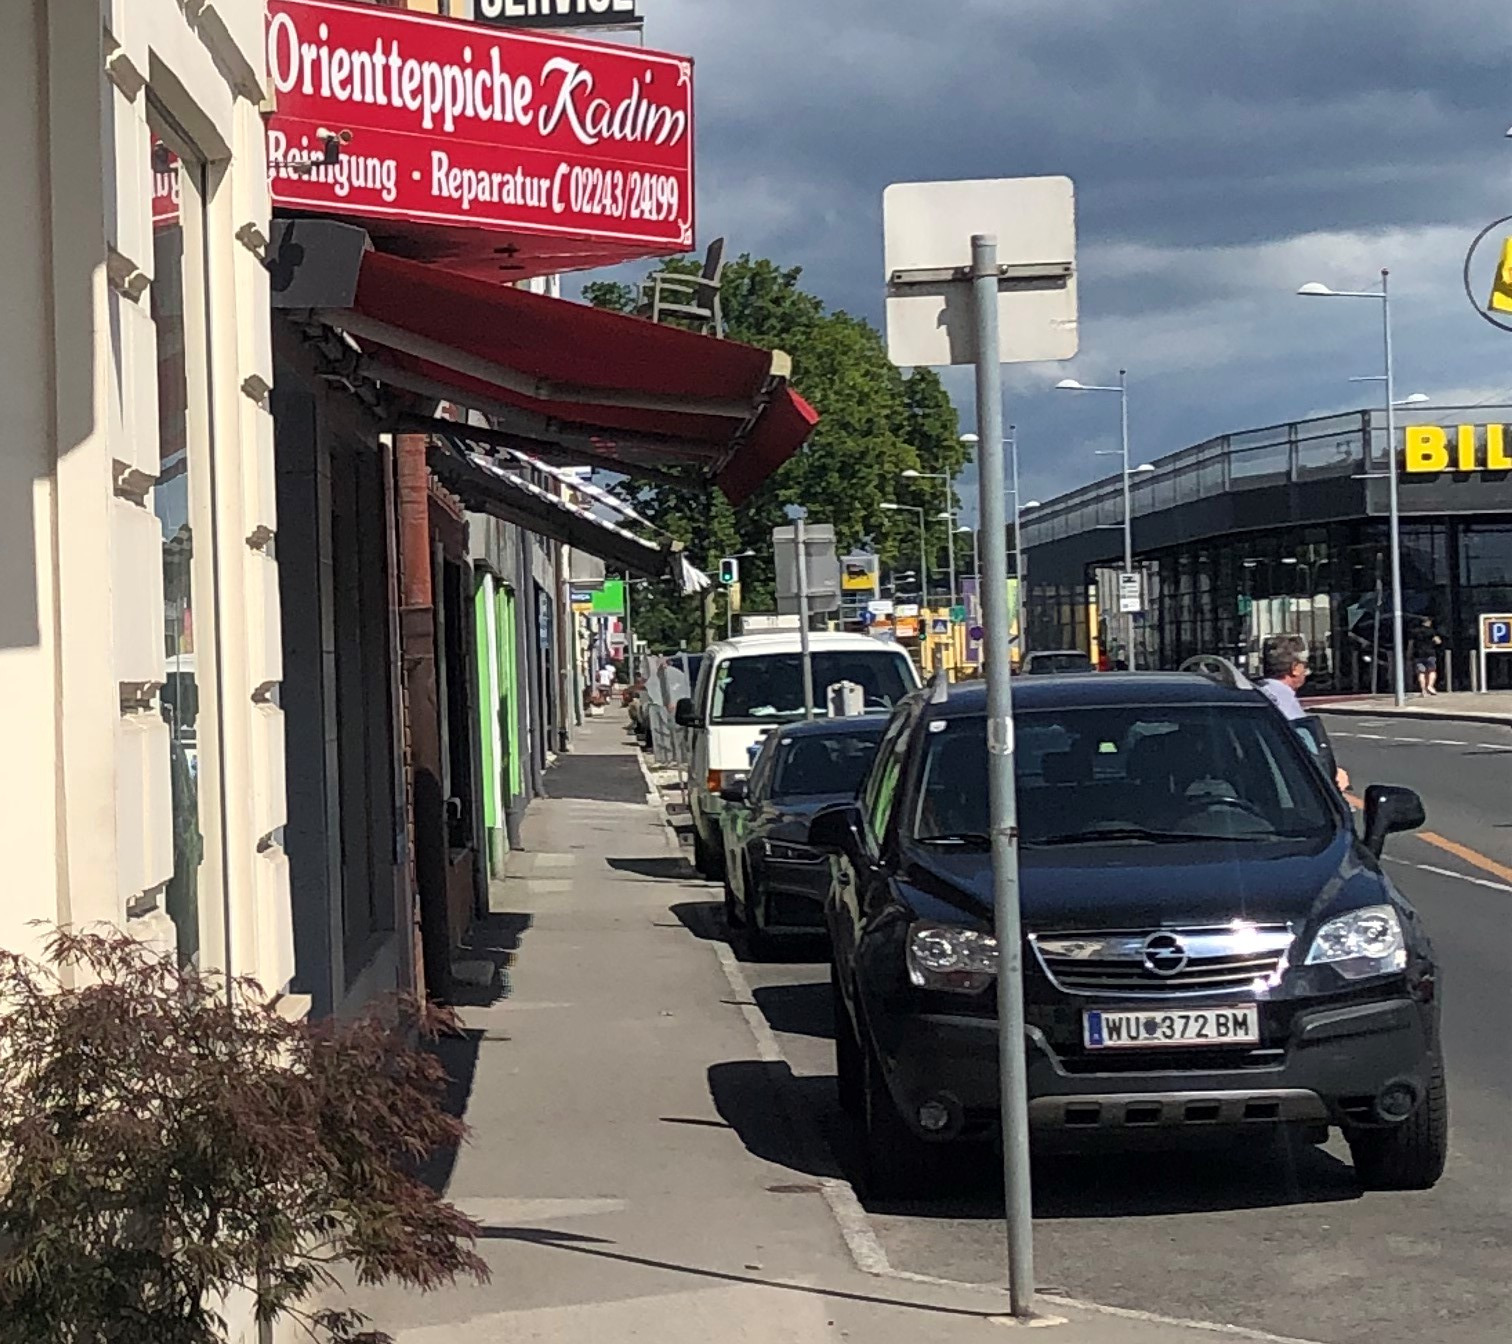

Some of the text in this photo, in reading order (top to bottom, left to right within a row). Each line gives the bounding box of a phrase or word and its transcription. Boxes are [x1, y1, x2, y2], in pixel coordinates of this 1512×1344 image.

[267, 11, 687, 146] Orientteppiche Kadim
[430, 150, 551, 210] Reparatur
[570, 165, 680, 222] 02243/24199
[1492, 622, 1507, 644] P
[1161, 1014, 1209, 1040] 372
[1215, 1011, 1249, 1038] BM
